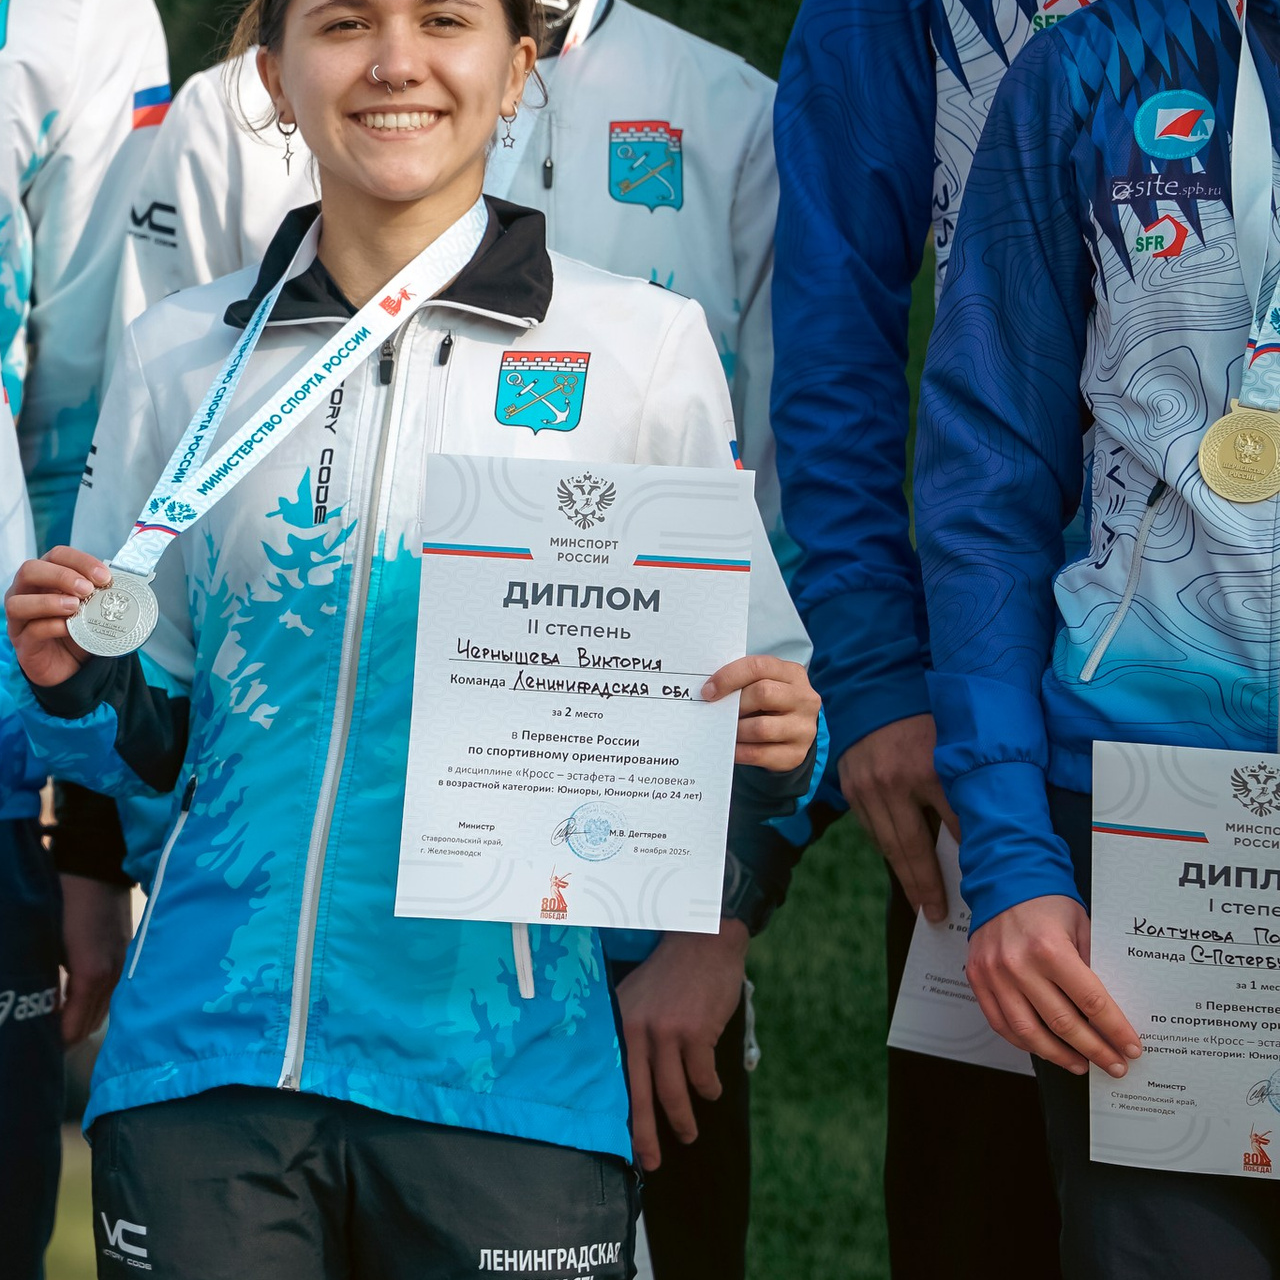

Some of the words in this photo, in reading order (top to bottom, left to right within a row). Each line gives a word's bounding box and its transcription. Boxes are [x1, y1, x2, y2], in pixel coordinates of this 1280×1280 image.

[1135, 234, 1165, 253] SFR
[196, 386, 227, 432] СПОРТА
[197, 413, 283, 496] МИНИСТЕРСТВО
[280, 372, 327, 415] СПОРТА
[322, 326, 372, 374] РОССИИ
[171, 435, 204, 484] РОССИИ
[313, 448, 334, 525] CODE
[549, 536, 619, 550] МИНСПОРТ
[556, 551, 609, 564] РОССИИ
[502, 580, 660, 613] ДИПЛОМ
[527, 618, 539, 634] II
[544, 622, 631, 640] степень
[449, 673, 506, 689] Команда
[551, 709, 562, 717] за
[574, 710, 604, 720] место
[521, 729, 594, 744] Первенстве
[596, 734, 640, 747] России
[467, 745, 483, 755] по
[485, 746, 569, 763] спортивному
[571, 752, 680, 766] ориентированию
[453, 766, 513, 777] дисциплине
[515, 767, 555, 780] «Кросс
[566, 771, 616, 784] эстафета
[636, 776, 696, 786] человека»
[445, 779, 500, 790] возрастной
[501, 783, 554, 794] категории:
[556, 785, 602, 797] Юниоры,
[603, 787, 650, 799] Юниорки
[651, 789, 668, 800] (до
[669, 790, 681, 799] 24
[682, 791, 702, 802] лет)
[457, 821, 496, 832] Министр
[627, 829, 667, 840] Дегтярев
[1233, 836, 1279, 849] РОССИ
[1178, 861, 1280, 891] ДИПЛ
[1127, 946, 1185, 963] Команда
[1235, 982, 1247, 990] за
[1205, 1000, 1280, 1014] Первенстве
[1150, 1014, 1167, 1023] по
[1169, 1015, 1258, 1031] спортивному
[1202, 1034, 1244, 1047] «Кросс
[1141, 1045, 1188, 1055] зрастной
[1189, 1049, 1245, 1059] категории:
[1147, 1080, 1187, 1092] Министр
[1110, 1090, 1175, 1104] Ставропольский
[1117, 1102, 1176, 1115] Железноводск
[478, 1241, 622, 1273] ЛЕНИНГРАДСКАЯ
